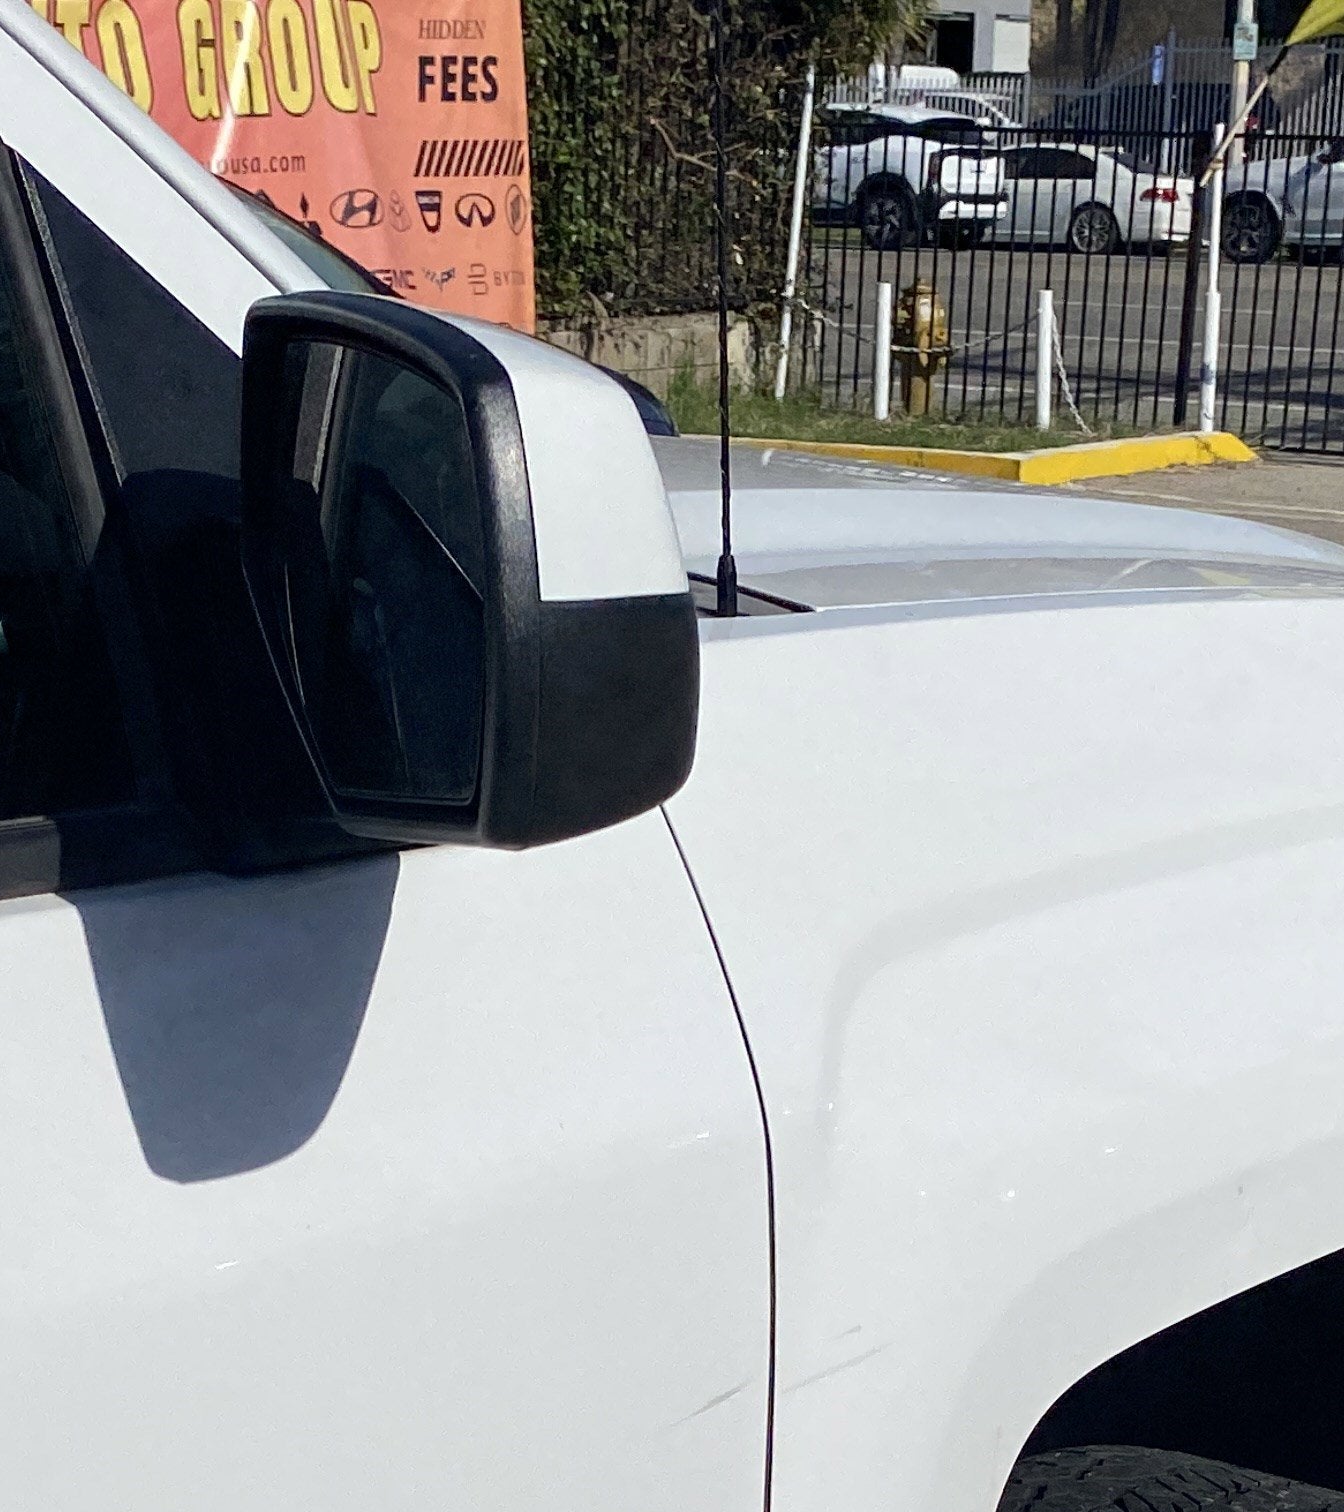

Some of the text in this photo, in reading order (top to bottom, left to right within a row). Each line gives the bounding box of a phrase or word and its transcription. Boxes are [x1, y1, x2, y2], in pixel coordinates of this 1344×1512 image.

[418, 19, 487, 39] HIDDEN
[31, 0, 382, 121] TO GROUP
[418, 55, 499, 103] FEES
